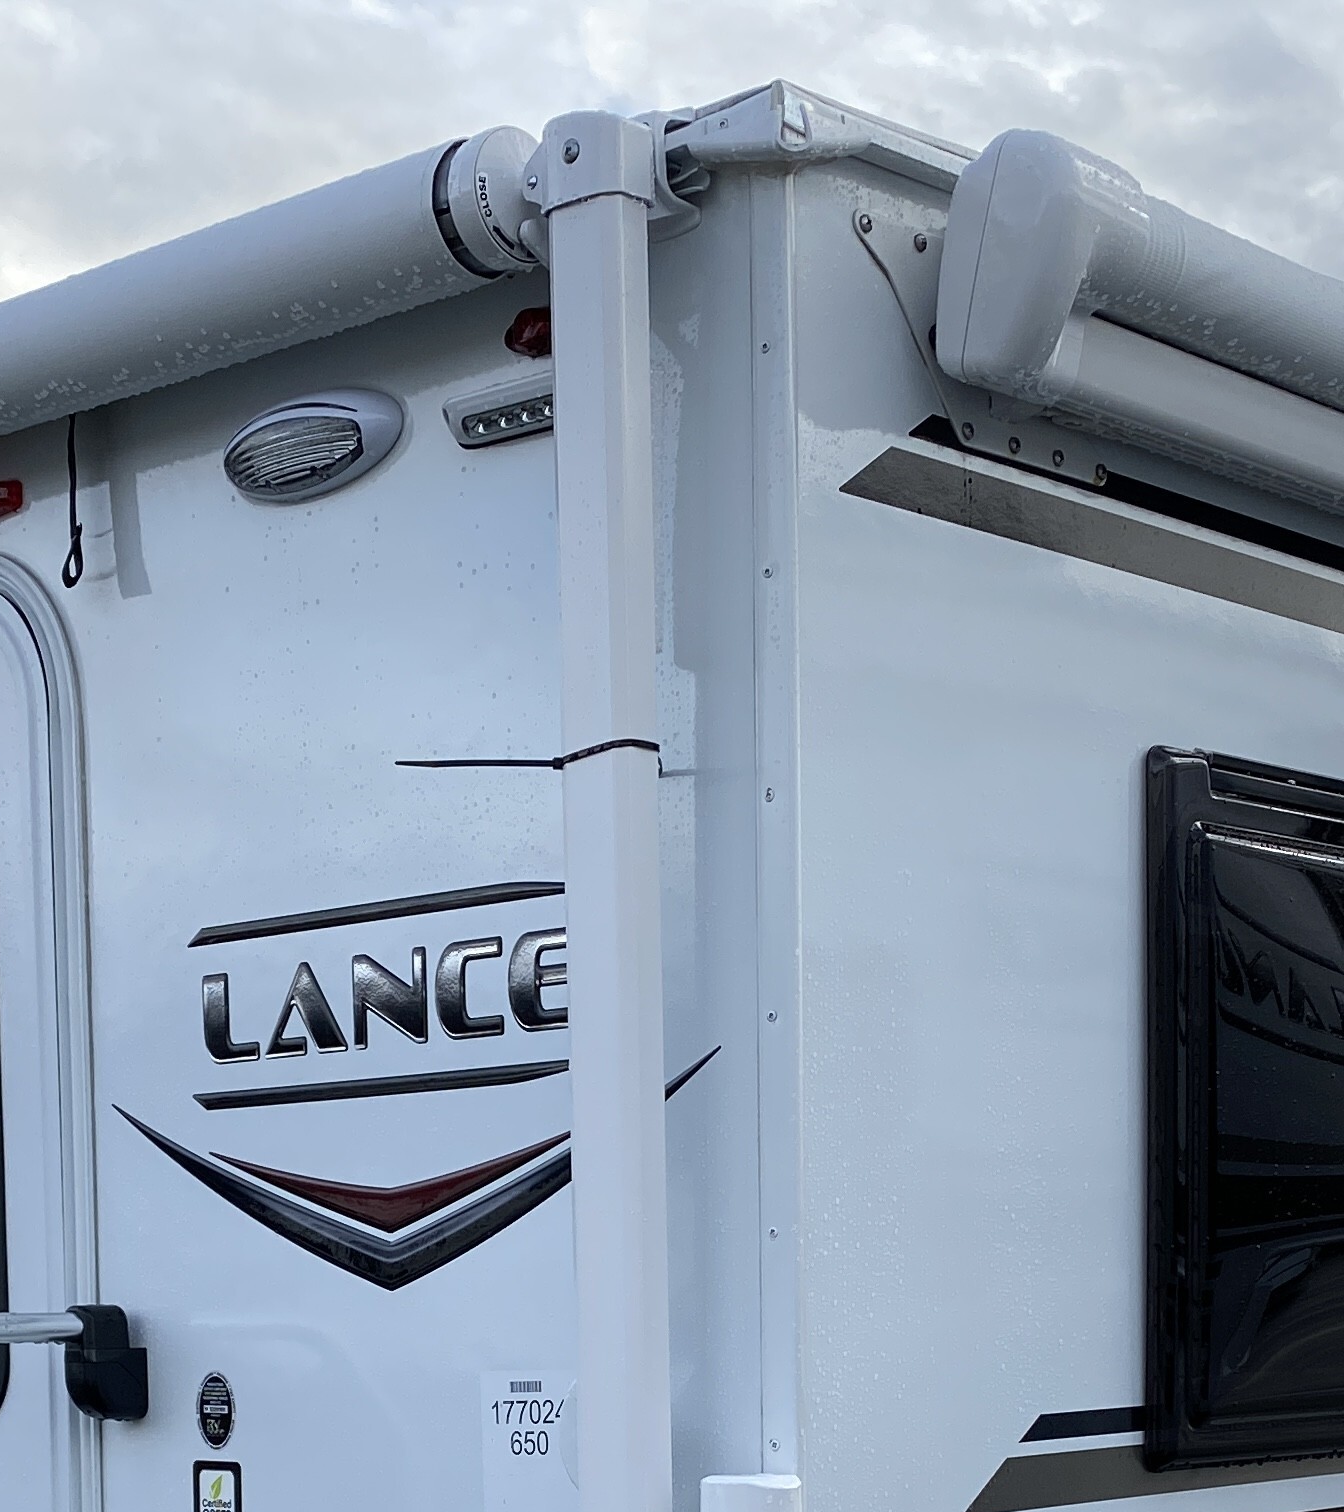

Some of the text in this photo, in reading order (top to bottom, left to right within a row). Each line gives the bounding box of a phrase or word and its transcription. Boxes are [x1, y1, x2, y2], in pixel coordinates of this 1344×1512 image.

[479, 175, 493, 218] CLOSE
[200, 927, 569, 1064] LANCE
[510, 1430, 549, 1456] 650
[202, 1498, 232, 1509] Certified
